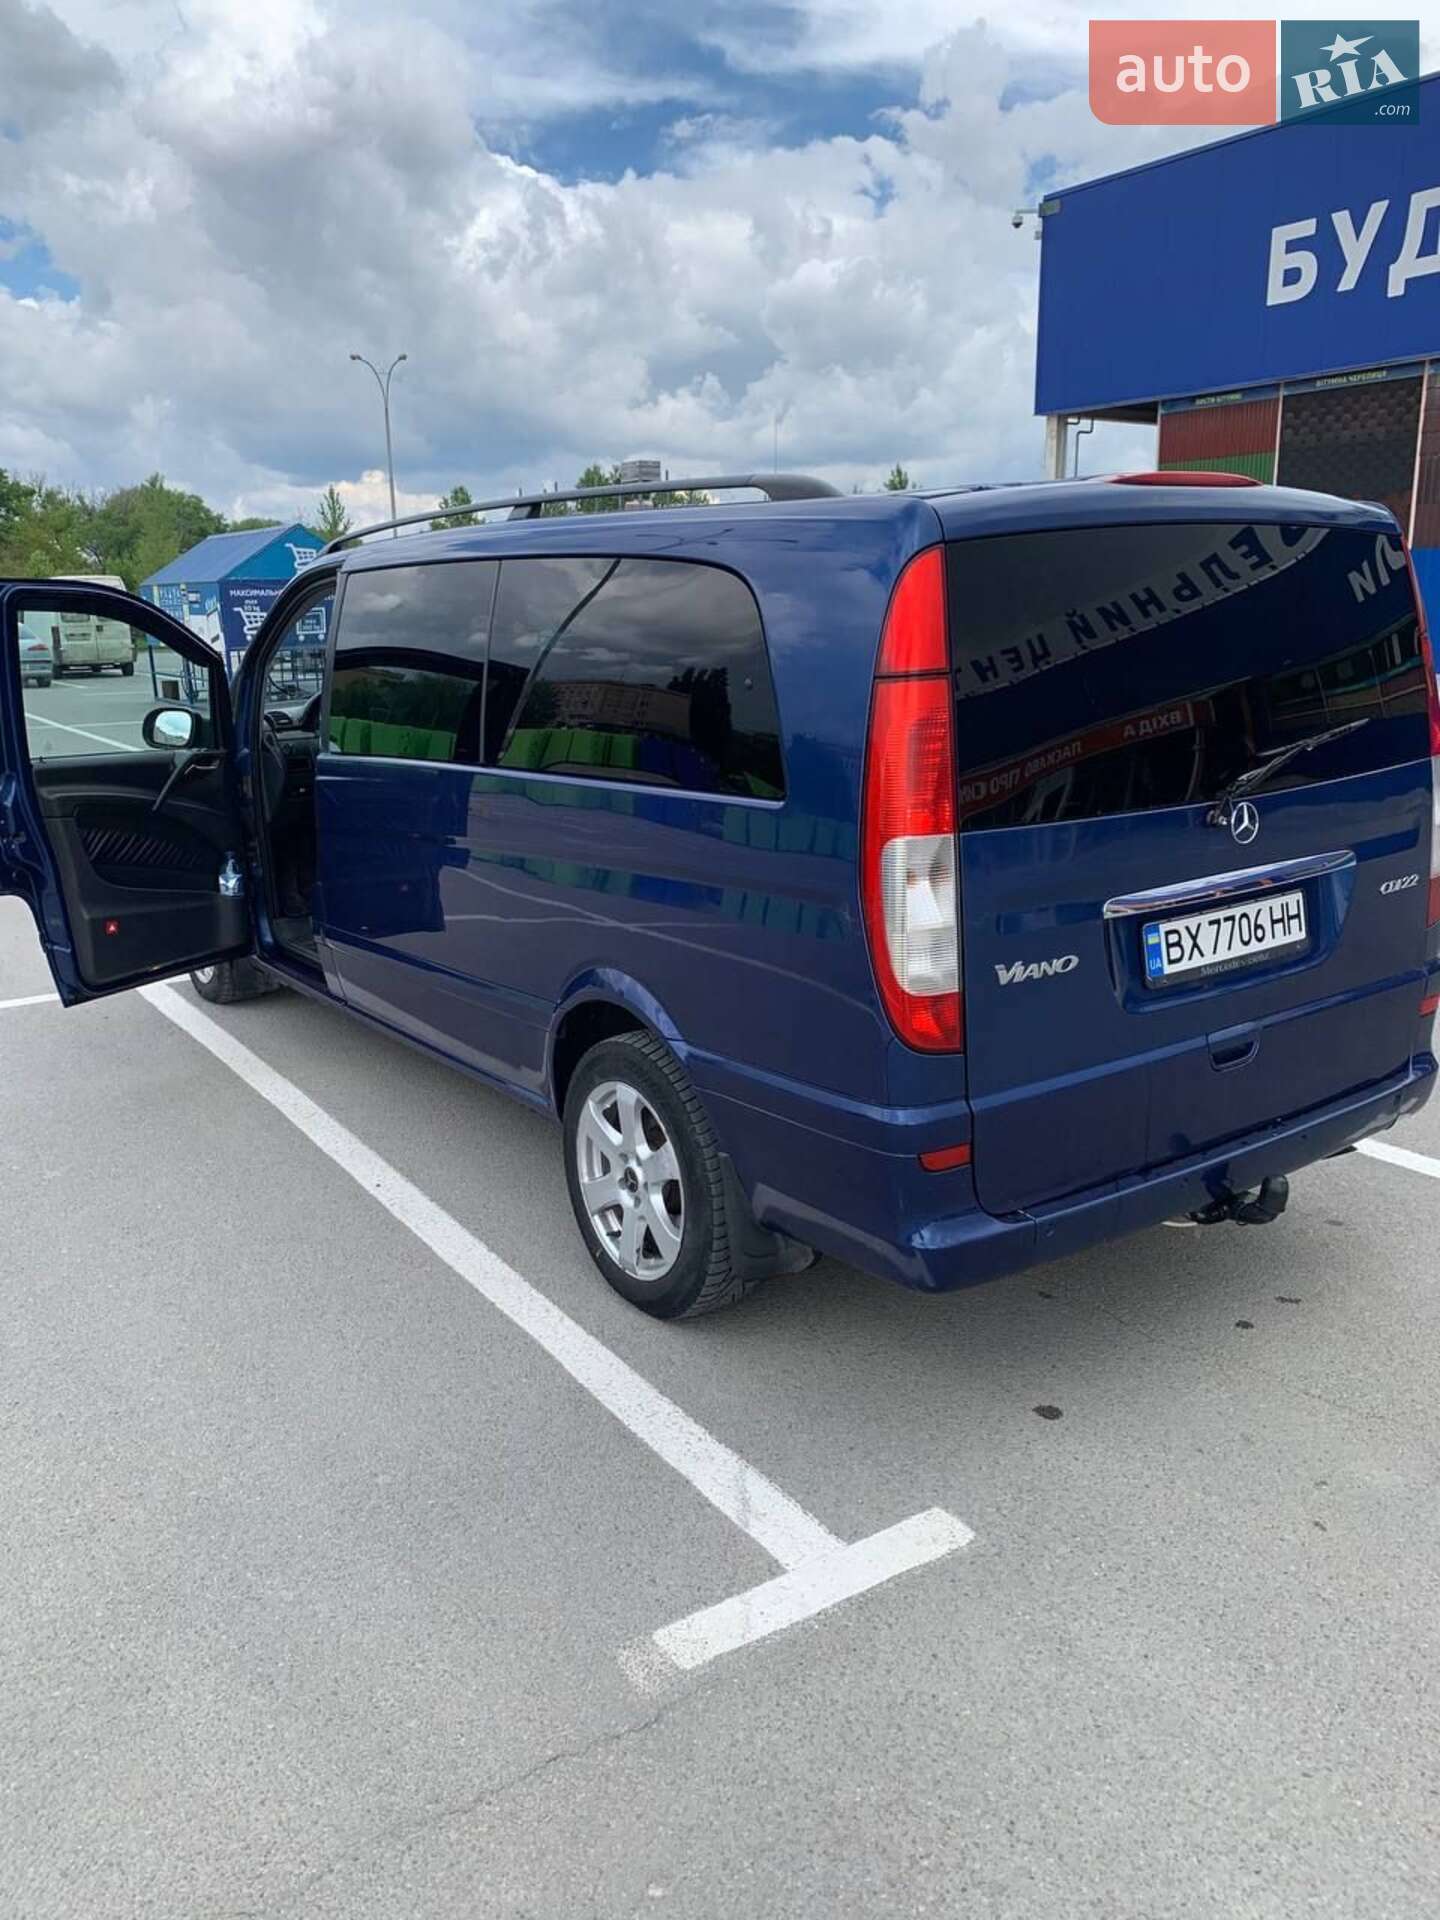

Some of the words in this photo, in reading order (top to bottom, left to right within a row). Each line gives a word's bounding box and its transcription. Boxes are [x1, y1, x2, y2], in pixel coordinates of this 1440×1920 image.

[1267, 186, 1440, 307] БУД
[1150, 957, 1162, 970] UA
[1164, 922, 1204, 966] BX
[1208, 908, 1266, 955] 7706
[1269, 899, 1302, 940] HH
